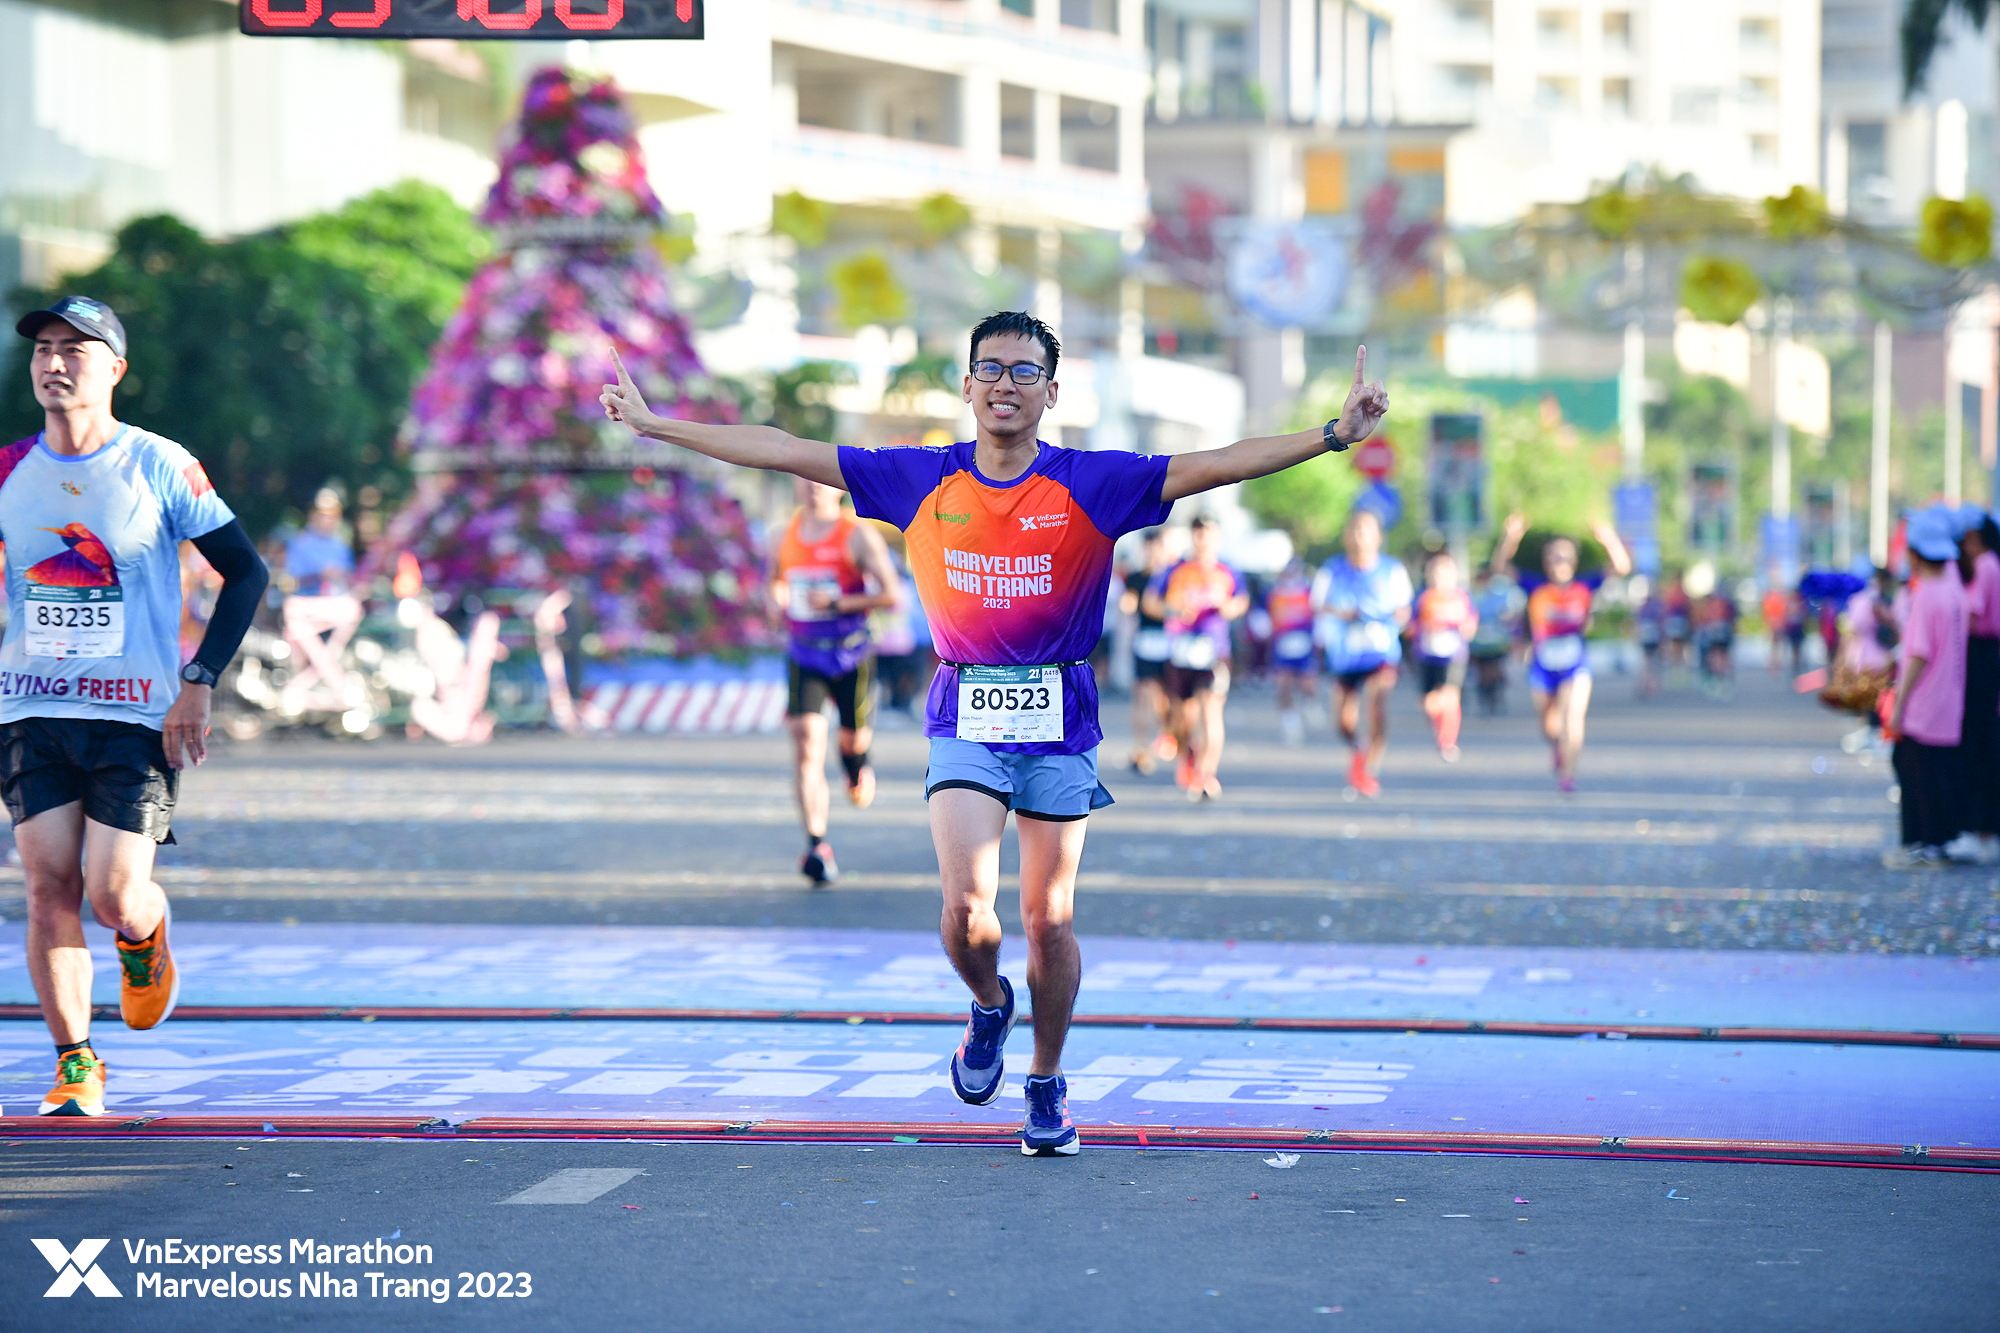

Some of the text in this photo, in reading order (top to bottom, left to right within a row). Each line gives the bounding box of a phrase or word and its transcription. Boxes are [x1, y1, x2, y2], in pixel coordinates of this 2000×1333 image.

[944, 547, 1052, 575] MARVELOUS
[946, 567, 1053, 598] NHA TRANG
[982, 597, 1011, 609] 2023
[37, 606, 110, 627] 83235
[77, 677, 152, 703] FREELY
[971, 687, 1050, 710] 80523
